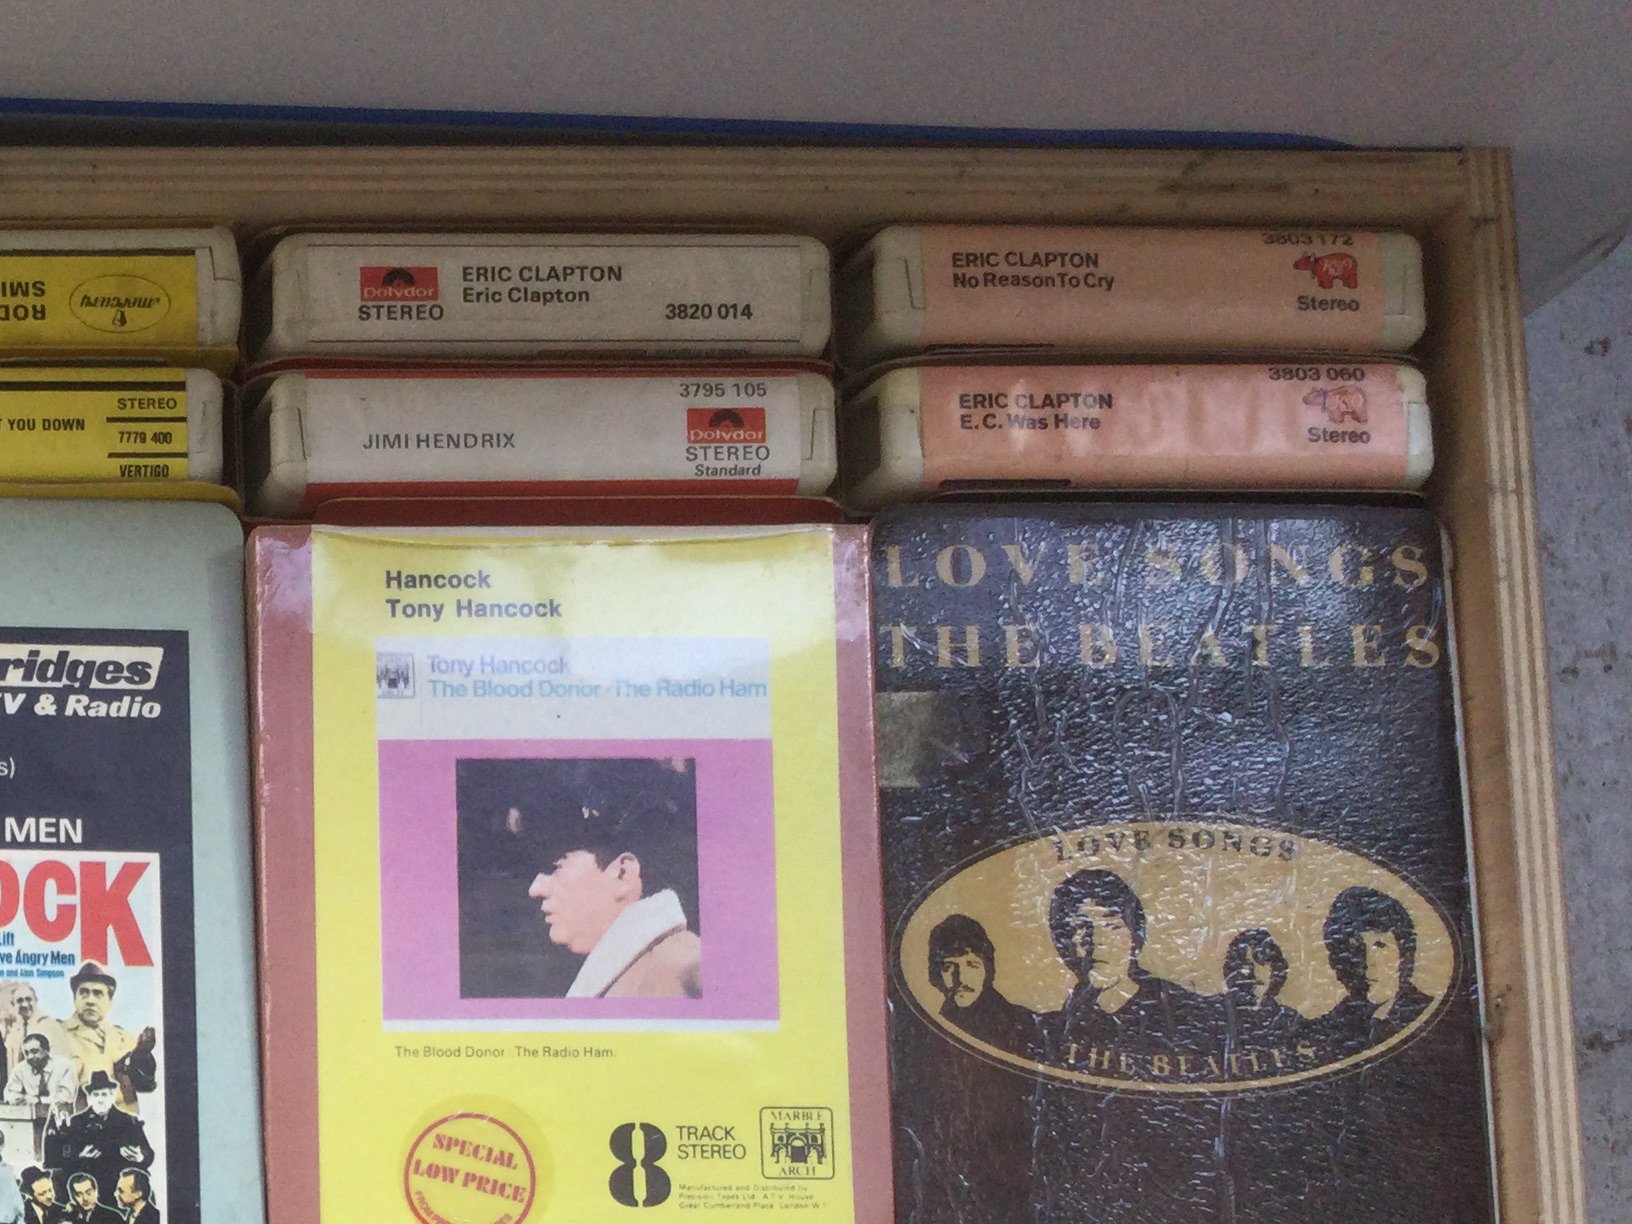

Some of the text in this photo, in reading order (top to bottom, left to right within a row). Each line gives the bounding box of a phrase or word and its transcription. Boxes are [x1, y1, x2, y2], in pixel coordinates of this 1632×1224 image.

[951, 251, 1100, 269] ERIC CLAPTON
[461, 265, 623, 284] ERIC CLAPTON
[461, 286, 591, 306] Eric Clapton
[357, 303, 445, 322] STEREO
[678, 381, 768, 398] 3795 105
[116, 397, 178, 411] STEREO
[958, 392, 1114, 411] ERIC CLAPTON
[7, 418, 37, 431] YOU
[41, 418, 86, 432] DOWN
[118, 430, 173, 445] 7779 400
[361, 432, 516, 450] JIMI HENDRIX
[684, 445, 771, 463] STEREO
[885, 542, 1430, 590] LOVE SONGS
[384, 569, 492, 592] Hancock
[385, 598, 563, 623] Tony Hancock
[877, 623, 1442, 670] THE BEATLES
[4, 816, 84, 844] MEN
[1054, 827, 1298, 862] LOVE SONGS
[15, 949, 49, 967] Angry
[50, 950, 76, 966] Men
[395, 1045, 421, 1059] The
[422, 1045, 462, 1059] Blood
[464, 1045, 506, 1059] Donor
[515, 1045, 540, 1059] The
[542, 1045, 581, 1059] Radio
[1067, 1043, 1319, 1078] THE BEATLES
[675, 1124, 736, 1142] TRACK
[432, 1133, 518, 1170] SPECIAL
[676, 1143, 747, 1161] STEREO
[608, 1121, 672, 1208] 8
[412, 1158, 527, 1203] LOW PRICE
